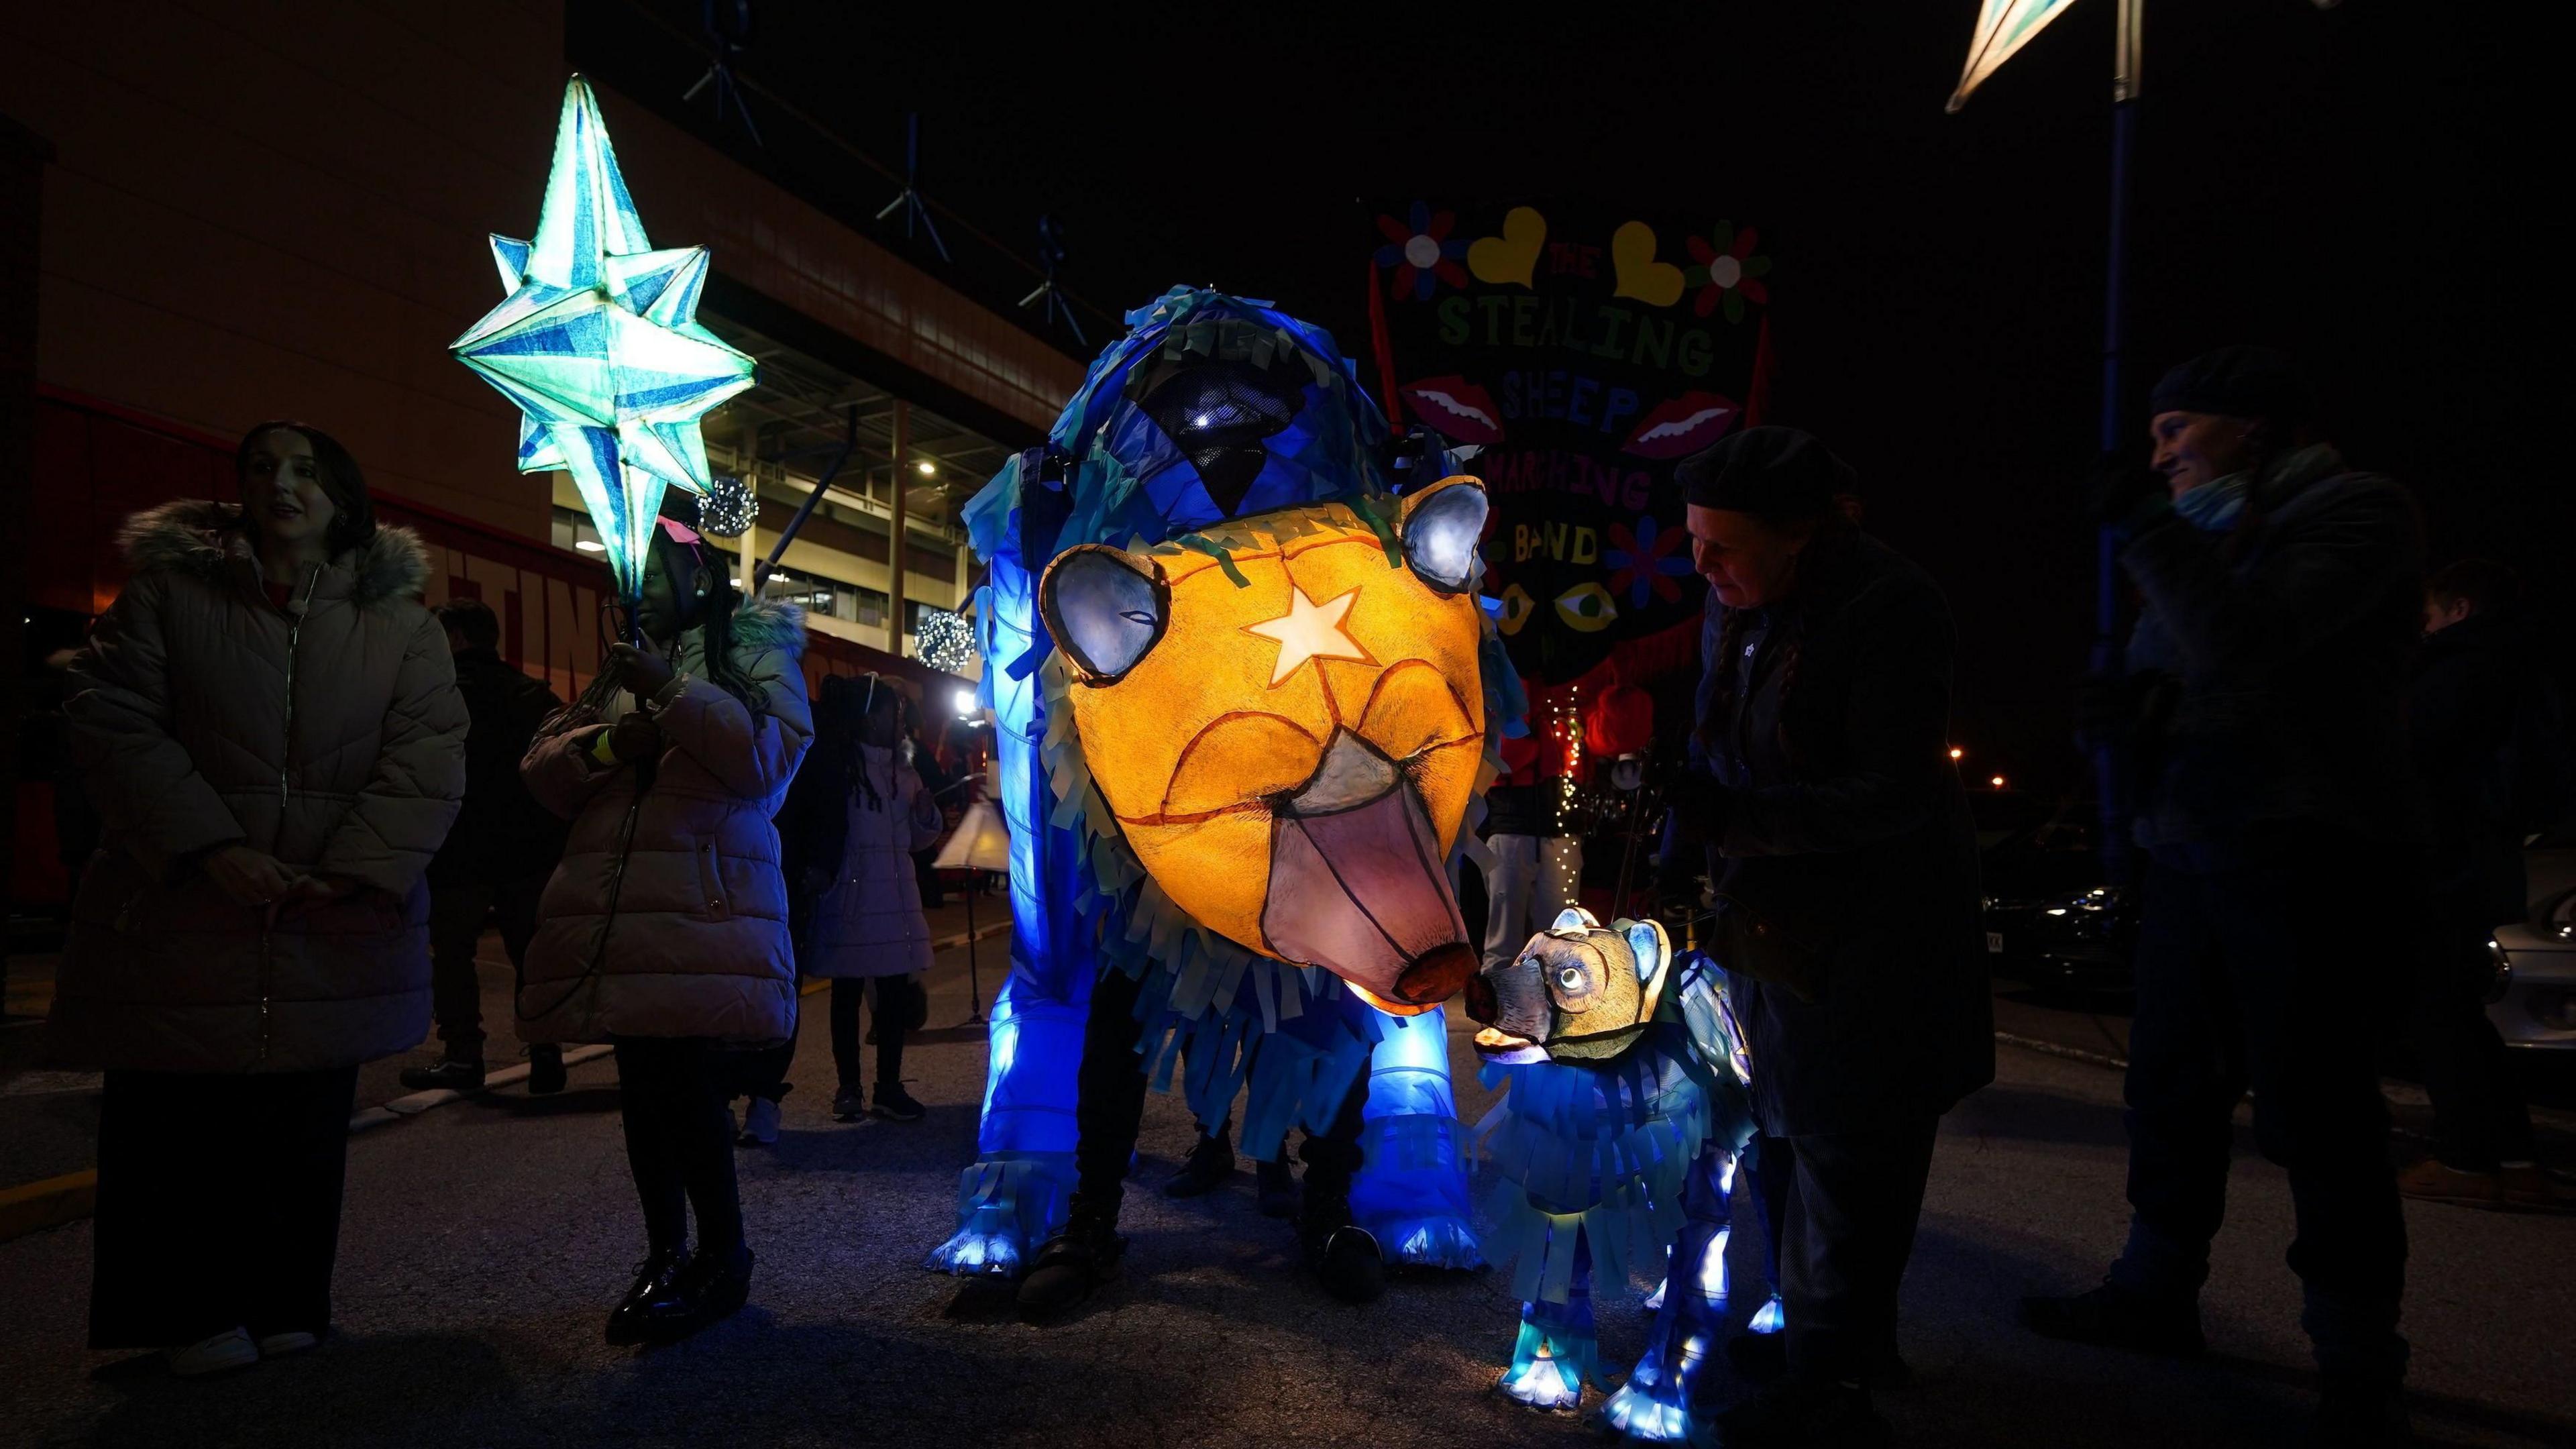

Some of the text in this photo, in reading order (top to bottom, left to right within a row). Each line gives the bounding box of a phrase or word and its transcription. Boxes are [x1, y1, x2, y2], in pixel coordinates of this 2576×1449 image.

[1548, 241, 1603, 278] THE
[1438, 295, 1714, 375] STEALING
[1503, 370, 1640, 433] SHEEP
[1485, 450, 1652, 510] MARCHING
[1514, 521, 1598, 565] BAND
